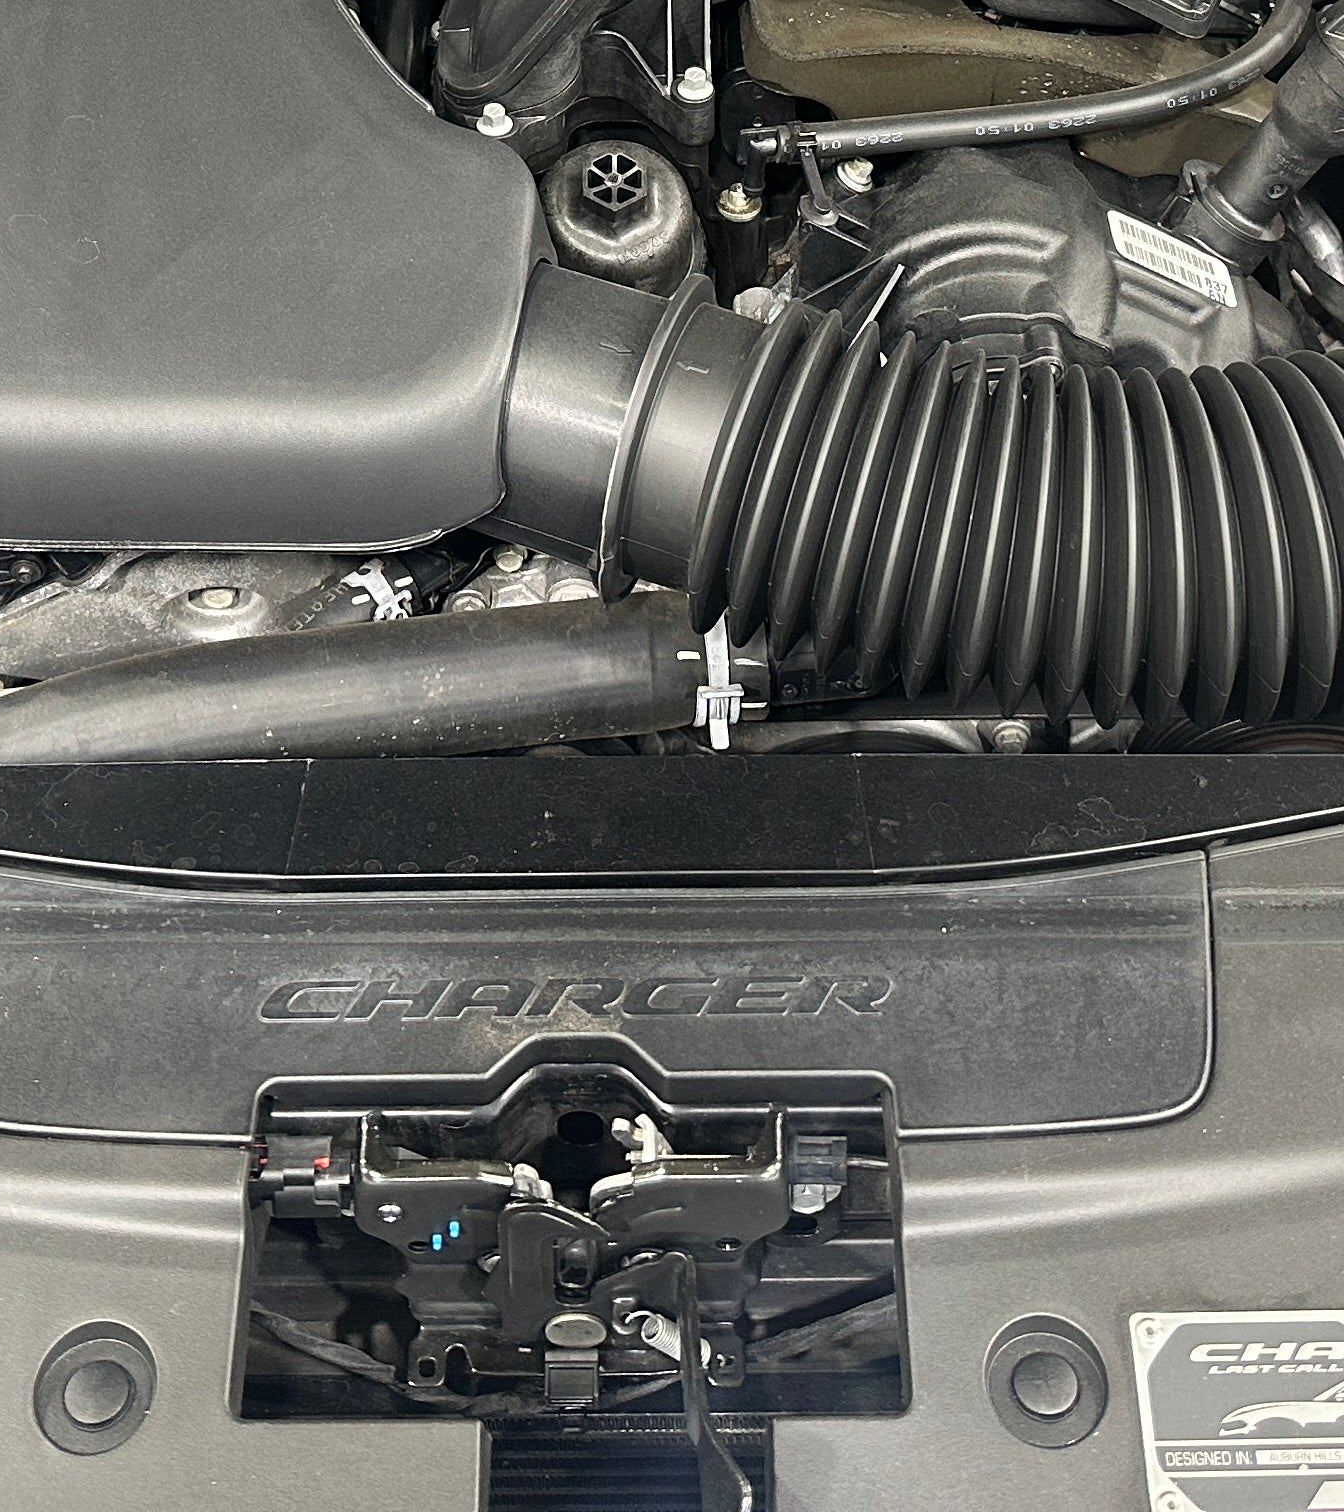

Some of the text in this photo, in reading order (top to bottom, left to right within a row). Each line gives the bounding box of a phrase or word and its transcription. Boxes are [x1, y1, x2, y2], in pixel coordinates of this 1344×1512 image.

[855, 130, 904, 148] 2263
[258, 977, 893, 1023] CHARGER
[1207, 1363, 1344, 1375] LAST CALL
[1164, 1450, 1232, 1467] DESIGNED
[1235, 1450, 1254, 1465] IN:
[1269, 1450, 1312, 1463] AUBURN
[1314, 1449, 1342, 1462] HILLS
